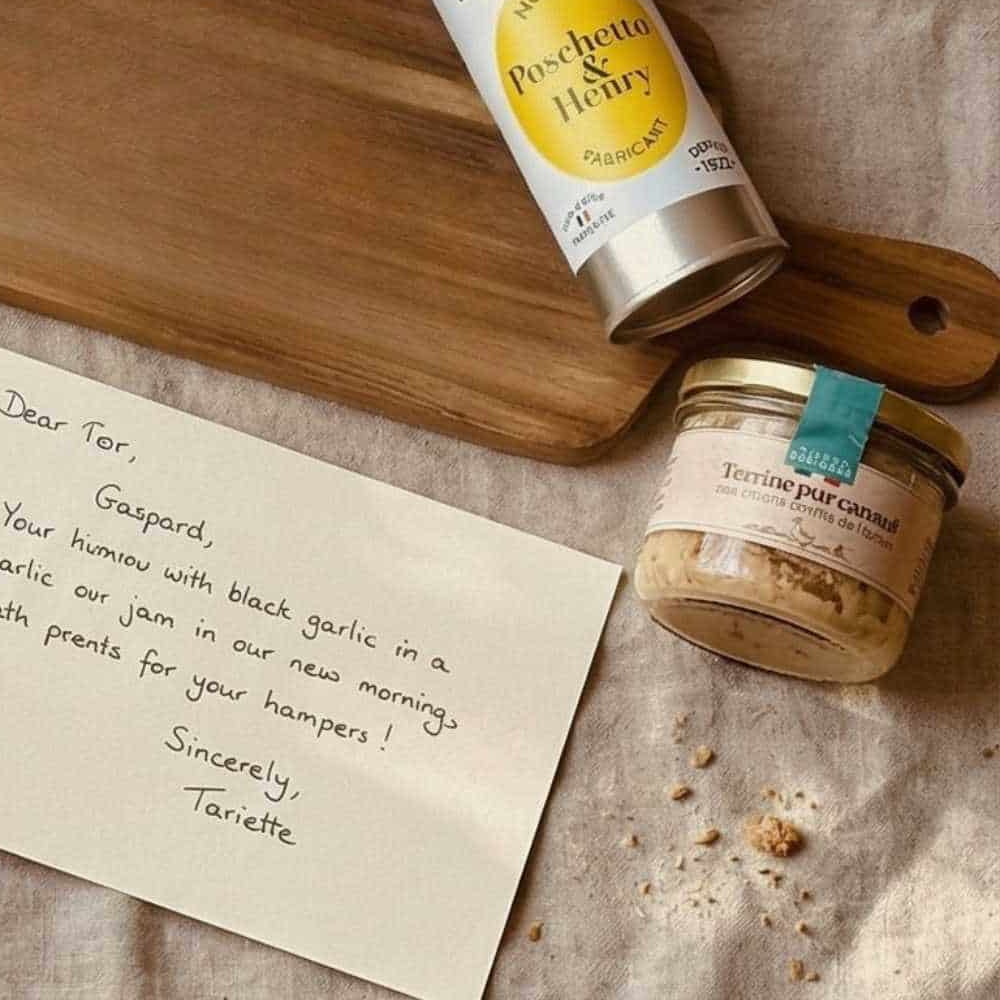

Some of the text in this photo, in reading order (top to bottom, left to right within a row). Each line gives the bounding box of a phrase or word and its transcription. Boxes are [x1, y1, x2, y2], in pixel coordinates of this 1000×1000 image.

[508, 17, 651, 96] Poschetto
[552, 64, 651, 123] Henry
[582, 54, 613, 84] &
[0, 389, 137, 464] Dear Tor,
[95, 483, 213, 549] Gaspard,
[722, 461, 795, 493] Terrine
[795, 484, 837, 505] pur
[3, 500, 55, 539] Your
[164, 565, 213, 595] with
[228, 580, 292, 620] black
[301, 619, 377, 648] garlic
[395, 639, 418, 662] in
[430, 656, 451, 674] a
[44, 624, 121, 660] prents
[138, 648, 177, 679] for
[185, 673, 248, 702] your
[74, 584, 110, 605] our
[118, 595, 175, 628] jam
[195, 618, 216, 643] in
[232, 638, 275, 660] our
[289, 658, 341, 683] new
[164, 725, 301, 803] Sincerely,
[183, 786, 297, 845] Tariette
